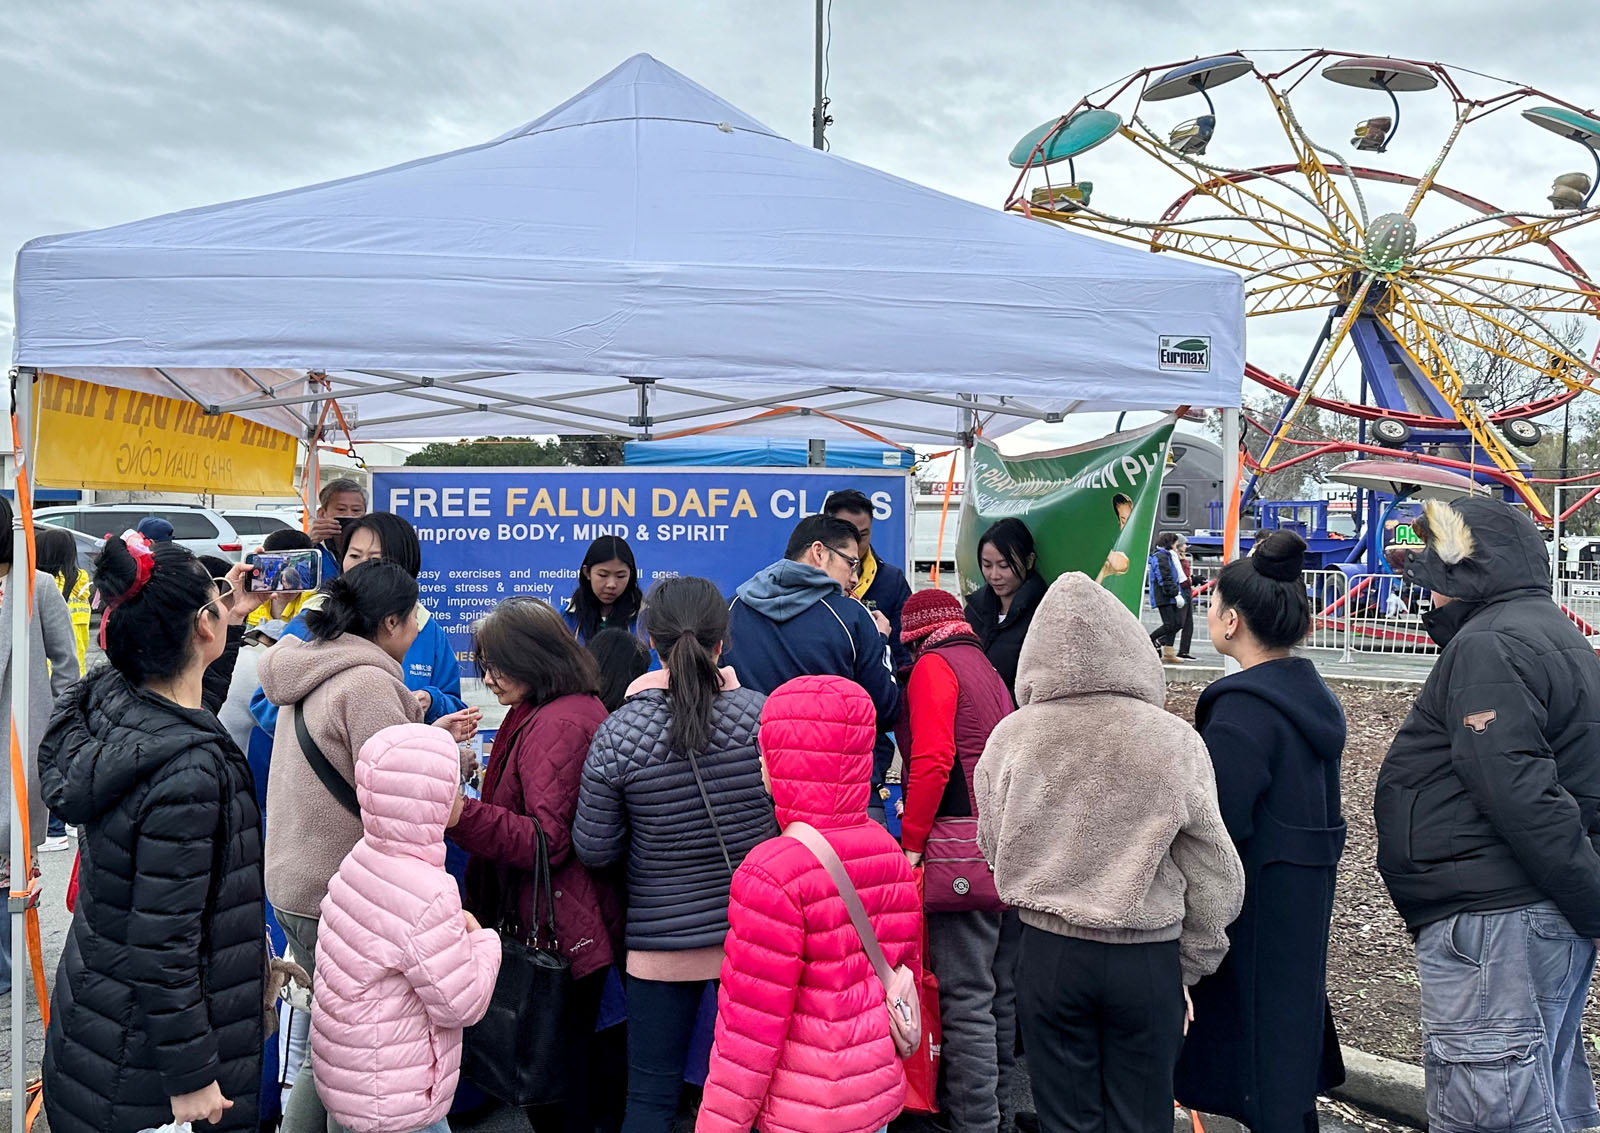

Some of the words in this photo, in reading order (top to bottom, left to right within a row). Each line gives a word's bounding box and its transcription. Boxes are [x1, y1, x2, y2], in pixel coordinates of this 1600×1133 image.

[1161, 350, 1204, 364] Eurmax
[389, 487, 491, 518] FREE
[506, 487, 636, 517] FALUN
[652, 488, 757, 518] DAFA
[497, 524, 565, 542] BODY,
[573, 524, 629, 540] MIND
[636, 524, 650, 541] &
[657, 525, 729, 541] SPIRIT
[448, 568, 502, 579] exercises
[509, 568, 531, 579] and
[454, 583, 489, 593] stress
[496, 581, 505, 593] &
[513, 582, 554, 594] anxiety
[447, 596, 498, 608] improves
